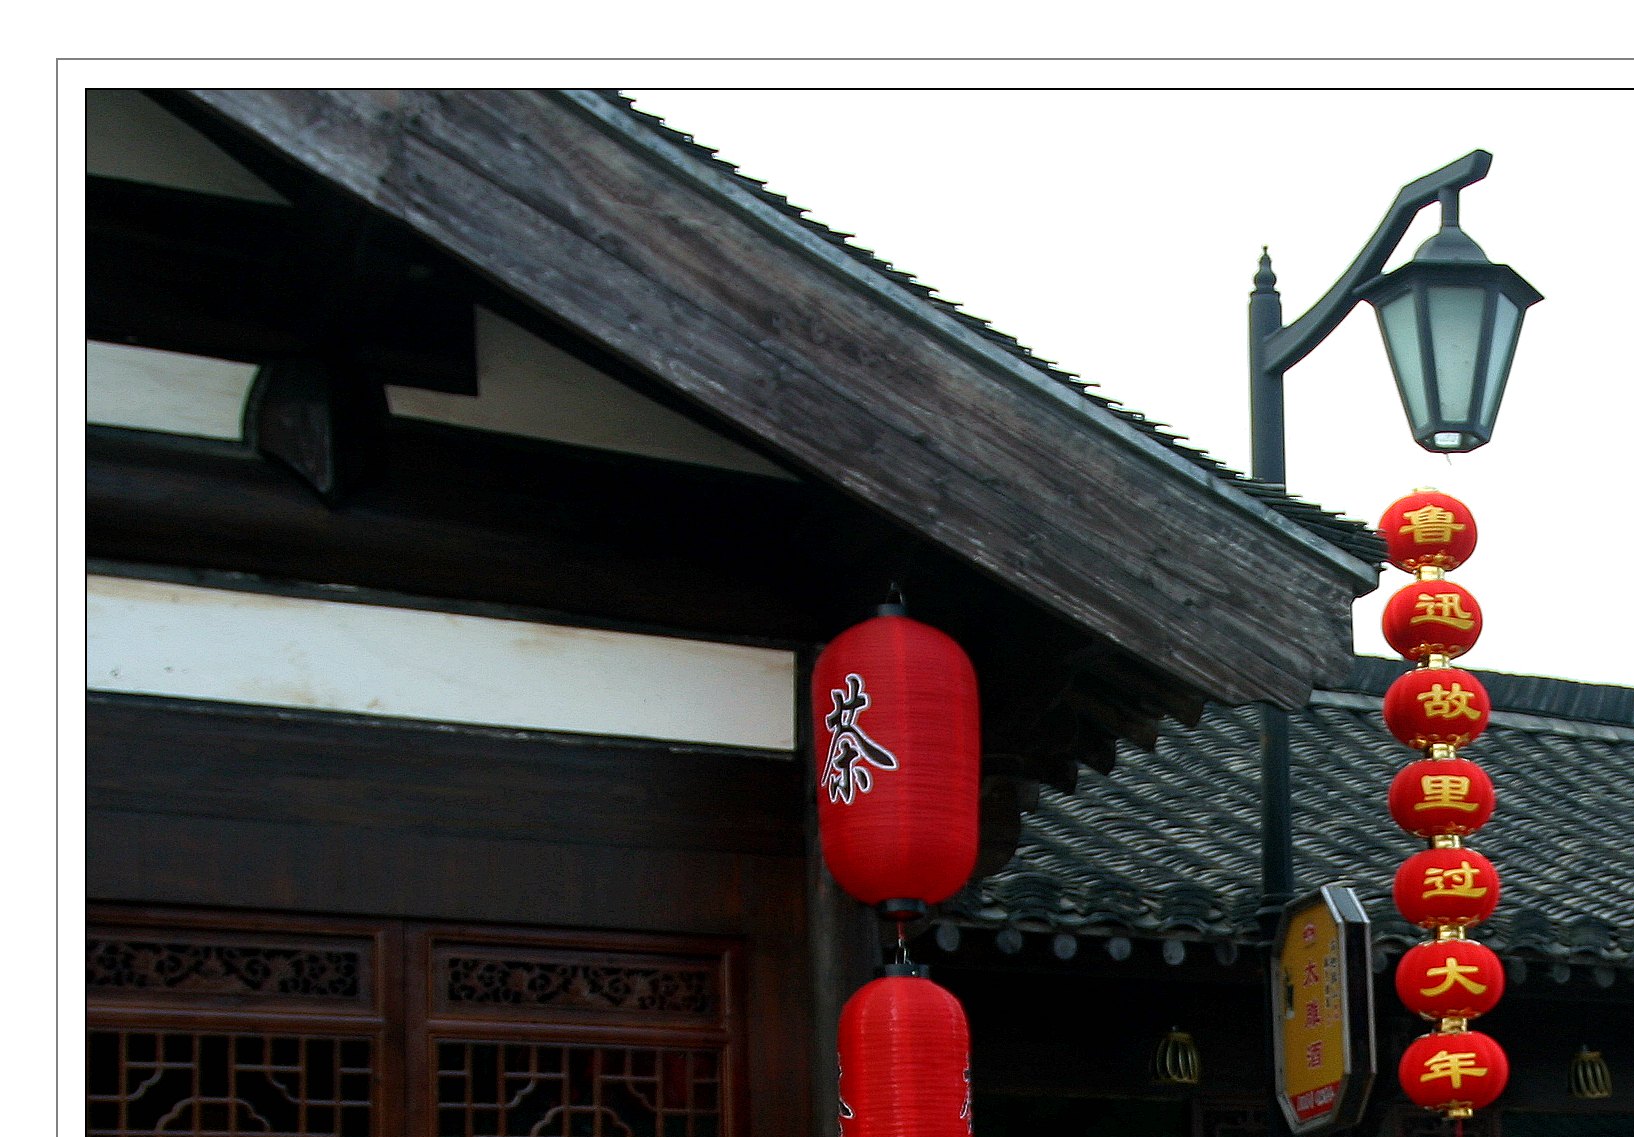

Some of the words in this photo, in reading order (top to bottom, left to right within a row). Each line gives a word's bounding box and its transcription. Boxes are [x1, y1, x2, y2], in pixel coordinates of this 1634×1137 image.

[821, 673, 898, 805] 茶
[1399, 503, 1488, 1089] 鲁迅故里过大年
